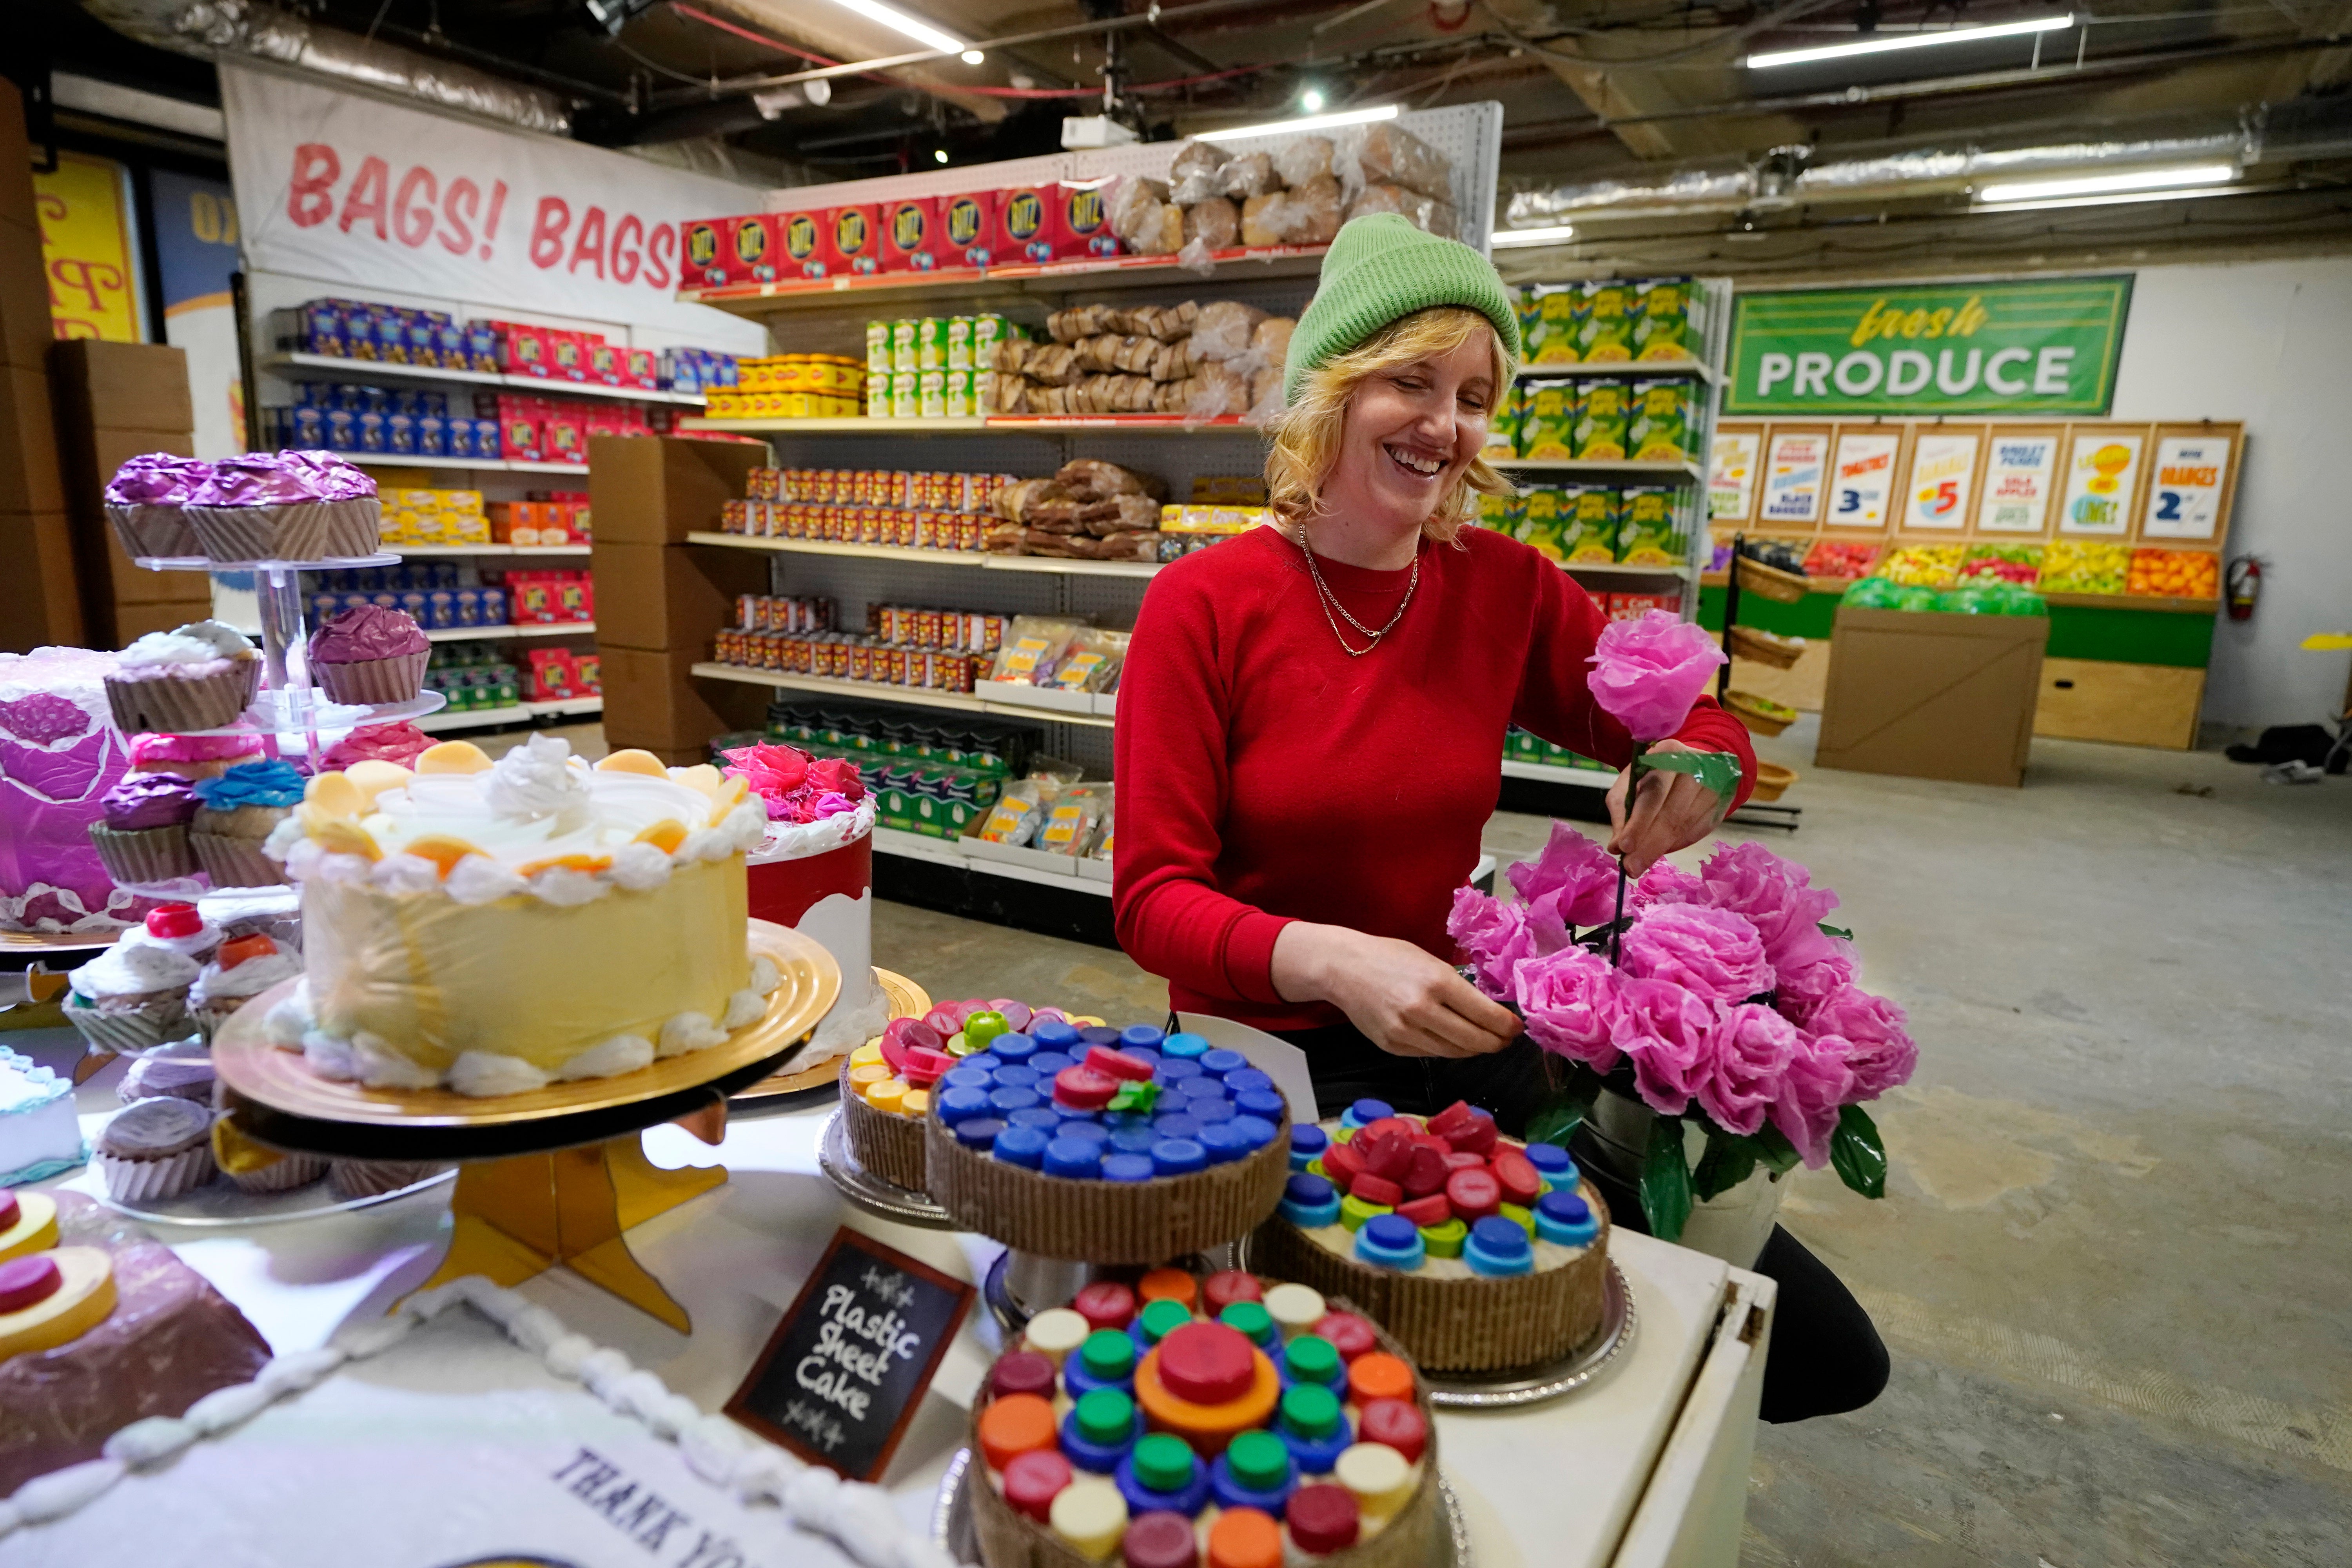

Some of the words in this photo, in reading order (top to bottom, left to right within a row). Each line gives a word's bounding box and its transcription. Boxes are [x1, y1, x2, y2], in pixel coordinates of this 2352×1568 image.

[287, 143, 509, 261] BAGS!
[529, 196, 675, 290] BAGS
[1850, 294, 1988, 347] fresh
[1757, 347, 2075, 397] PRODUCE
[1838, 489, 1860, 513] 3
[1934, 481, 1959, 516] 5
[2156, 492, 2180, 521] 2
[820, 1284, 920, 1359] Plastic
[812, 1321, 890, 1386] Sheet
[796, 1356, 871, 1421] Cake
[550, 1446, 691, 1553] THANK
